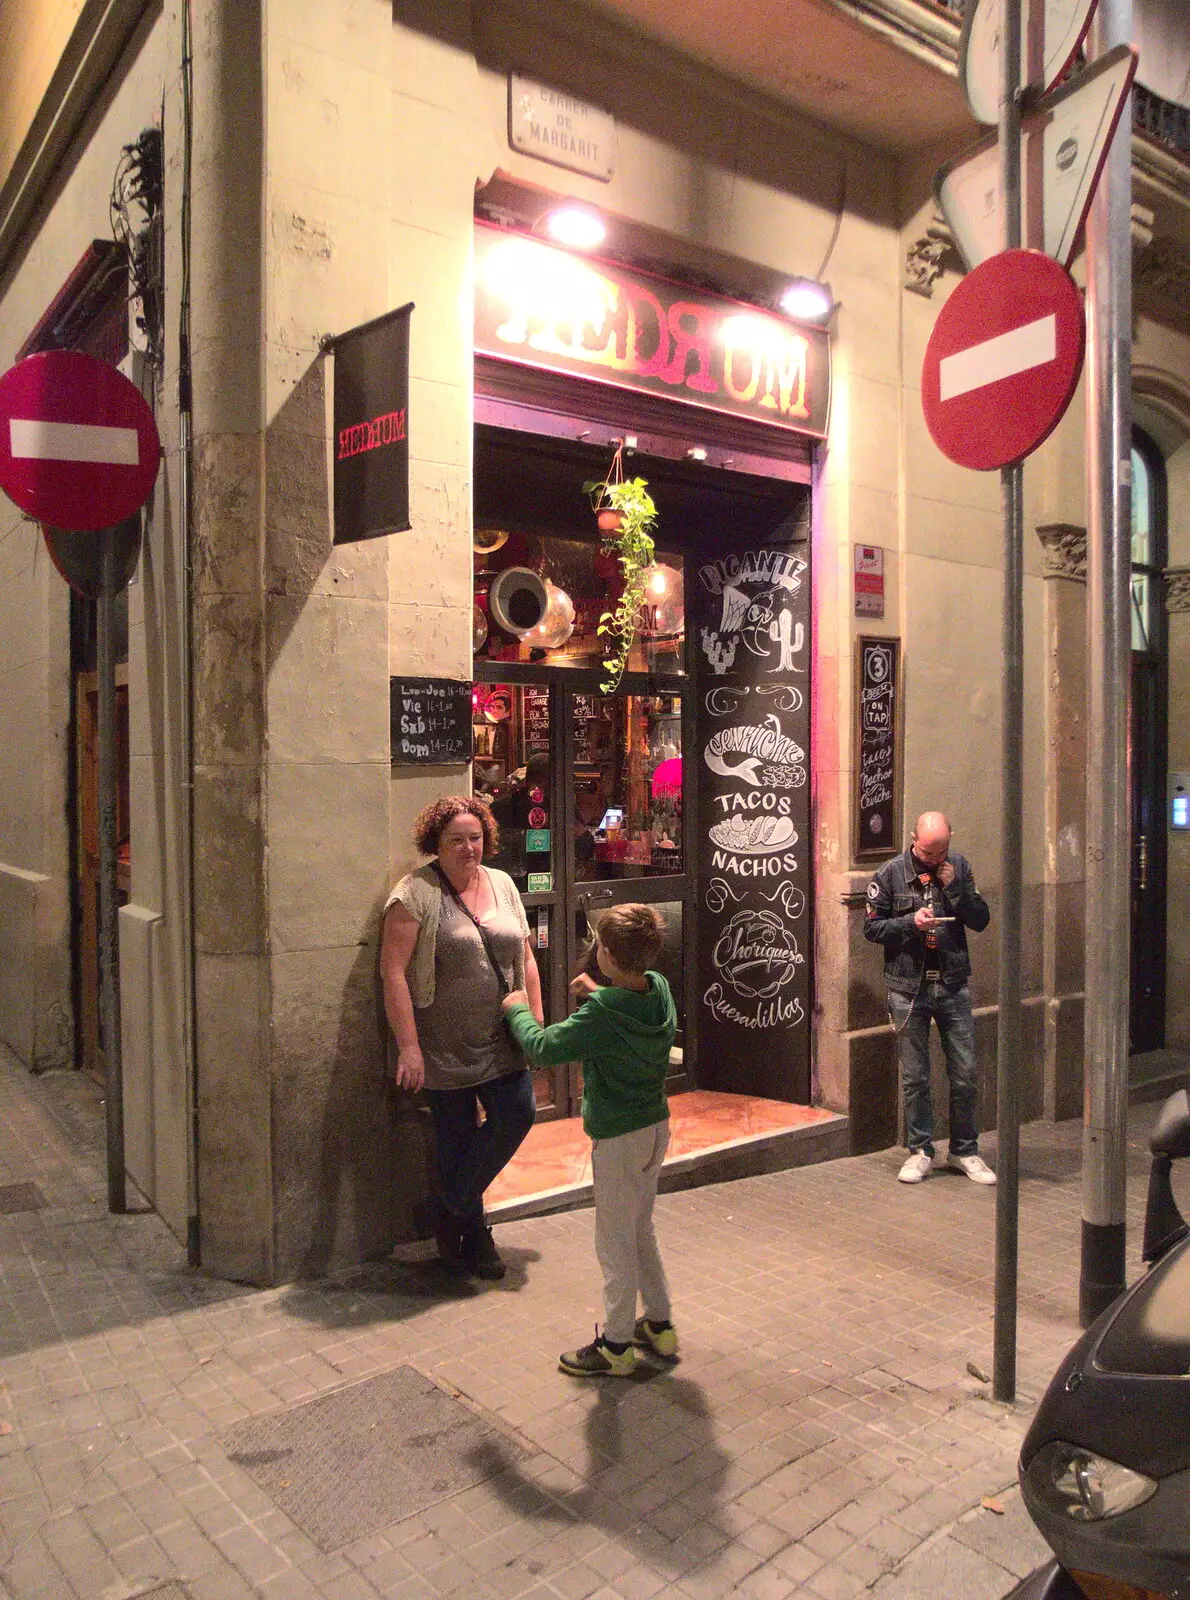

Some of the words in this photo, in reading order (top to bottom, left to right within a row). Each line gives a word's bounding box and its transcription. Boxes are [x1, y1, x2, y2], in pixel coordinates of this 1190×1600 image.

[556, 114, 572, 130] DE
[529, 121, 599, 160] MARGARIT
[699, 551, 808, 595] PICANTE
[873, 656, 884, 678] 3
[402, 699, 421, 713] Vie
[871, 702, 883, 710] ON
[401, 714, 425, 735] Sab
[868, 712, 886, 723] TAP
[401, 739, 429, 757] Dom
[714, 791, 791, 815] TACOS
[711, 850, 798, 877] NACHOS
[703, 982, 805, 1029] Quesadillas
